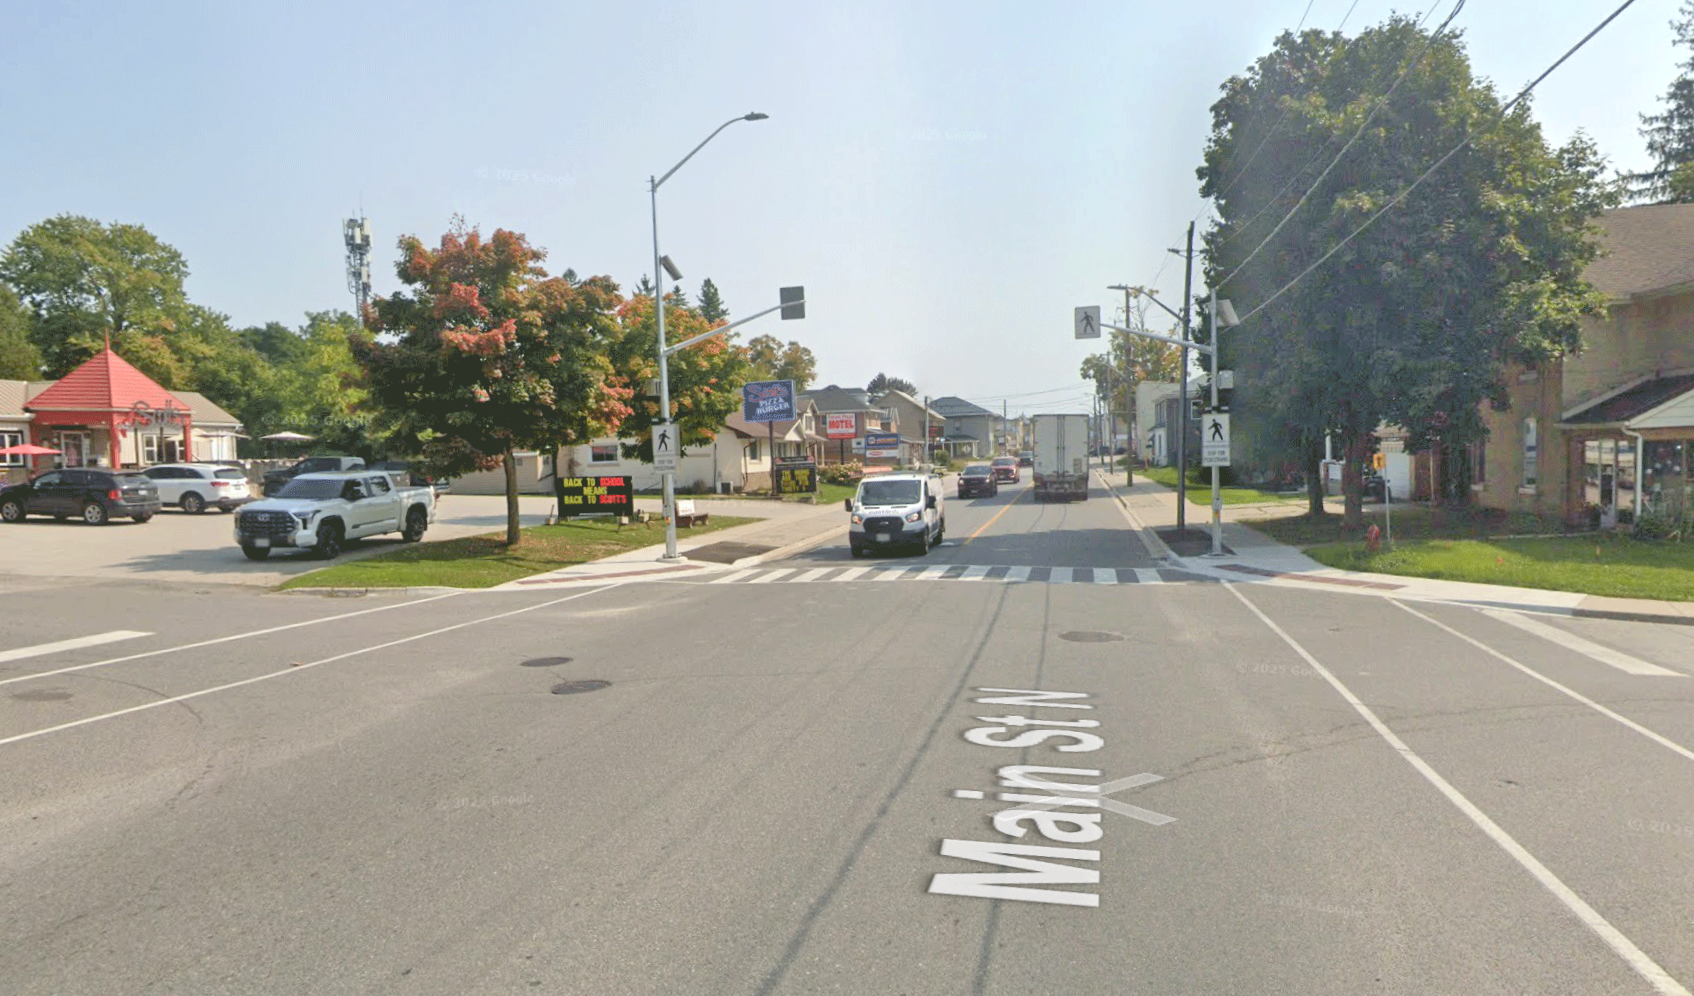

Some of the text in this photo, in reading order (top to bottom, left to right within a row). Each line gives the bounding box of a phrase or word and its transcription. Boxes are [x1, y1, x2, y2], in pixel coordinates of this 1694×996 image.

[759, 396, 785, 407] PIZZA
[756, 402, 790, 414] BURGER
[828, 419, 854, 430] MOTEL
[563, 476, 625, 488] BACK TO SCHOOL
[582, 486, 608, 496] MEANS
[563, 494, 627, 505] BACK TO SCOTT'S
